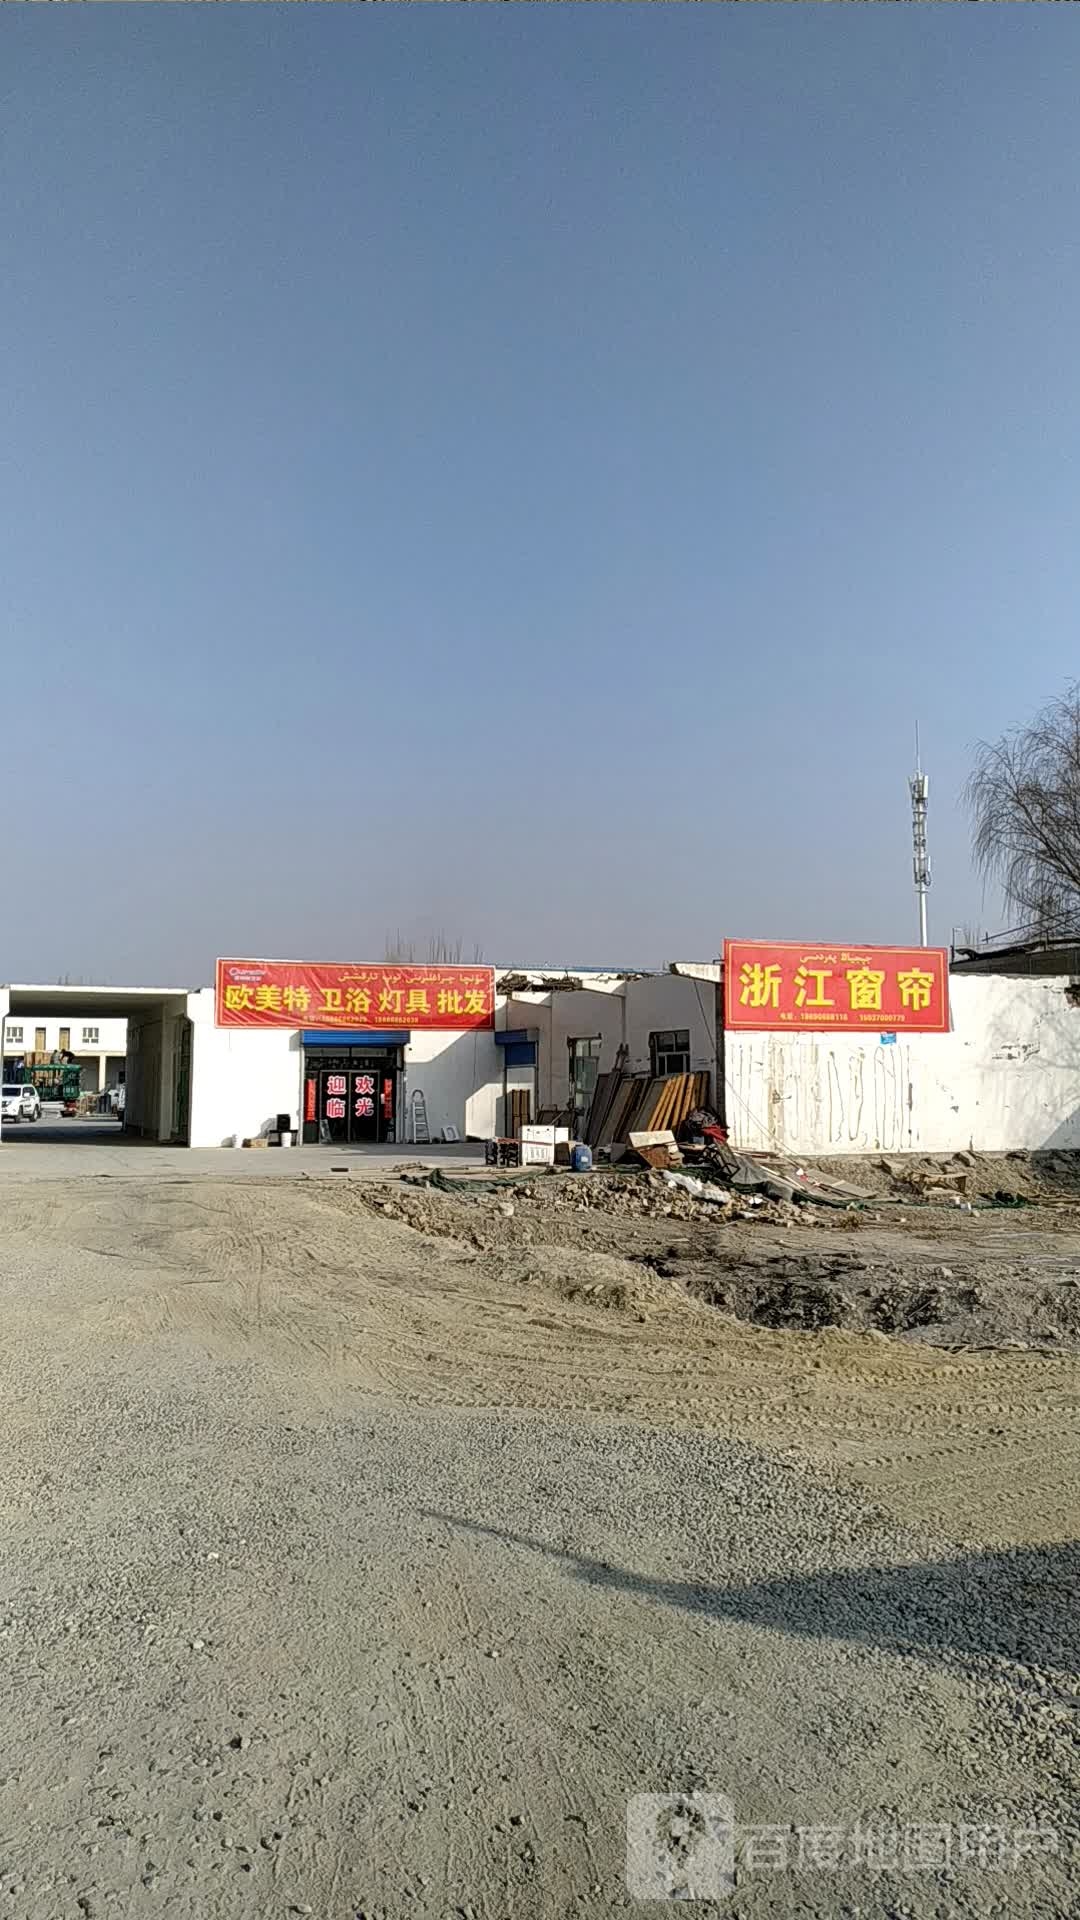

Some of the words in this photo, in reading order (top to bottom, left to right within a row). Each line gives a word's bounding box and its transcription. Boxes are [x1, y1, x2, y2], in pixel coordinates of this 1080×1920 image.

[225, 983, 312, 1011] 欧美特
[318, 986, 372, 1014] 卫浴
[379, 988, 431, 1015] 灯具
[437, 989, 490, 1016] 批发
[738, 961, 934, 1012] 浙江窗帘
